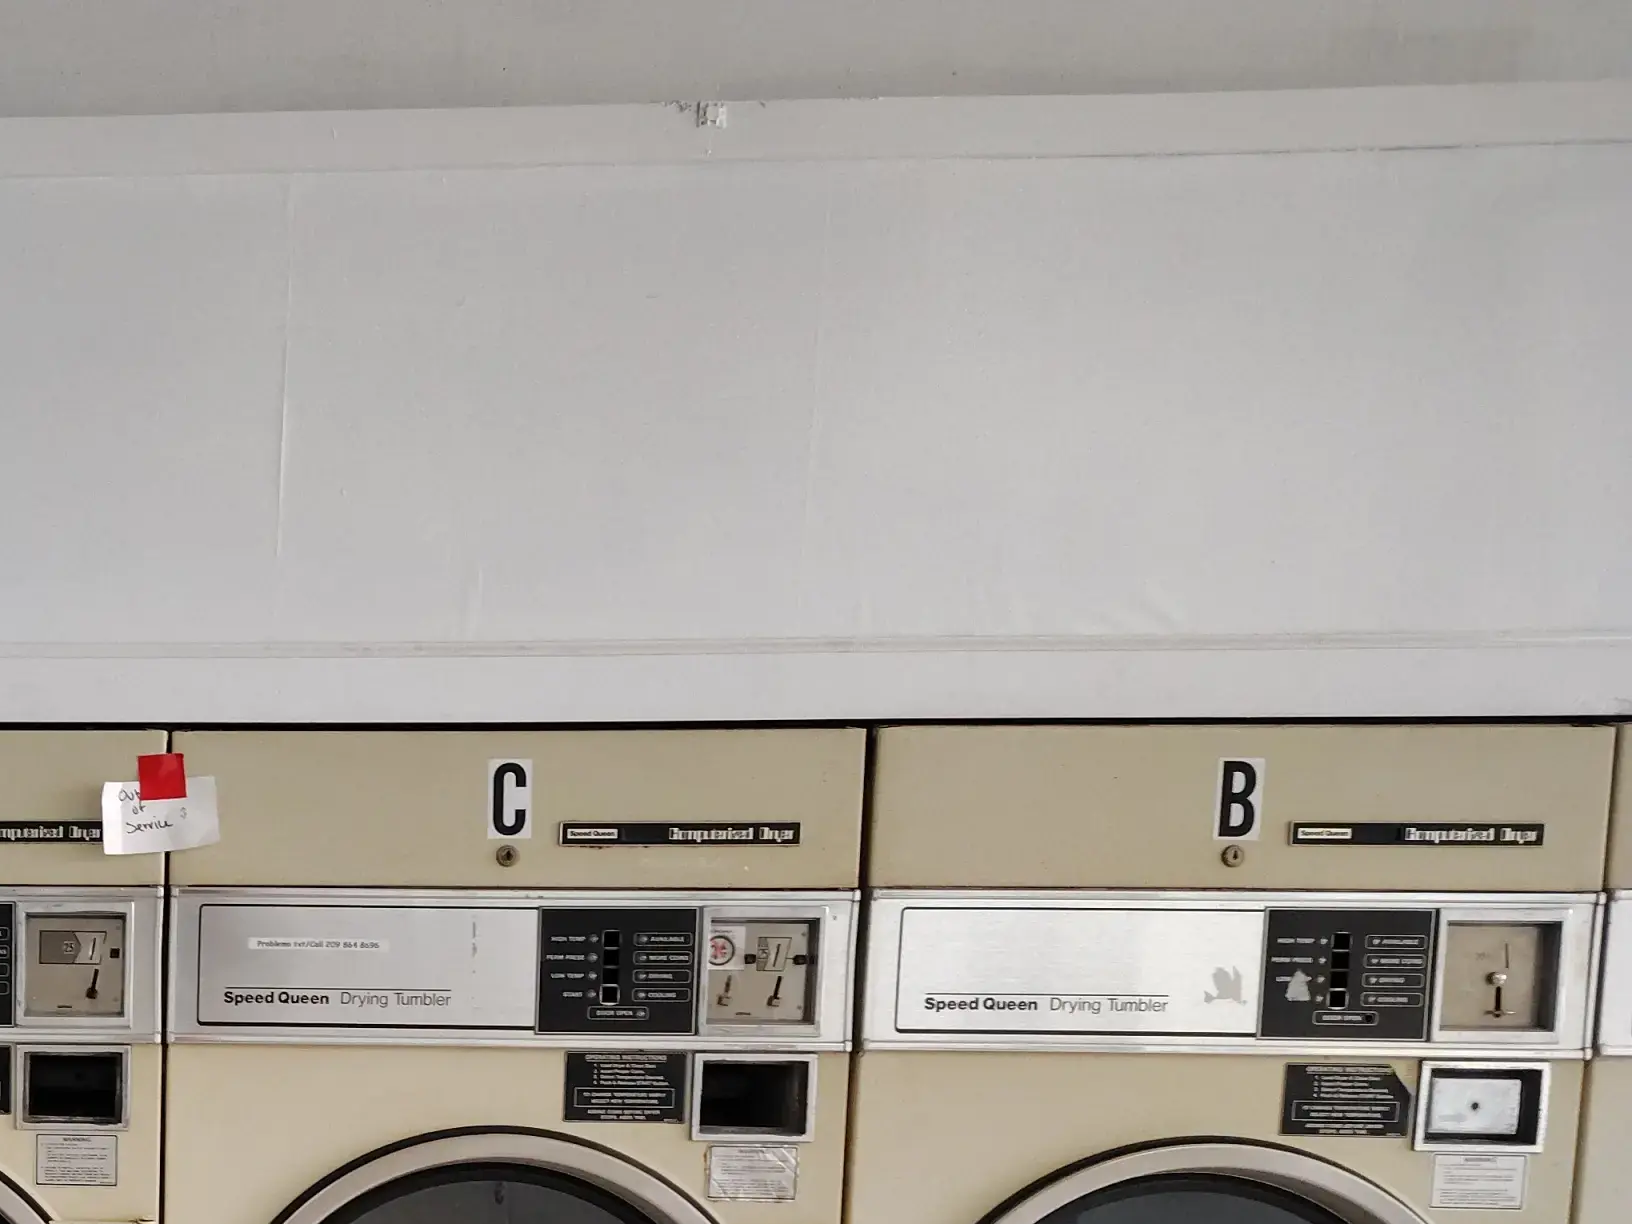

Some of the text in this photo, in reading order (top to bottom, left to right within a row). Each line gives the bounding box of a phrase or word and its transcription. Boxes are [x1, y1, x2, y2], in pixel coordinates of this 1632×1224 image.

[492, 762, 527, 836] C
[1219, 760, 1256, 837] B
[224, 991, 452, 1008] Speed Queen Drying Tumbler
[924, 997, 1169, 1014] Speed Queen Drying Tumbler
